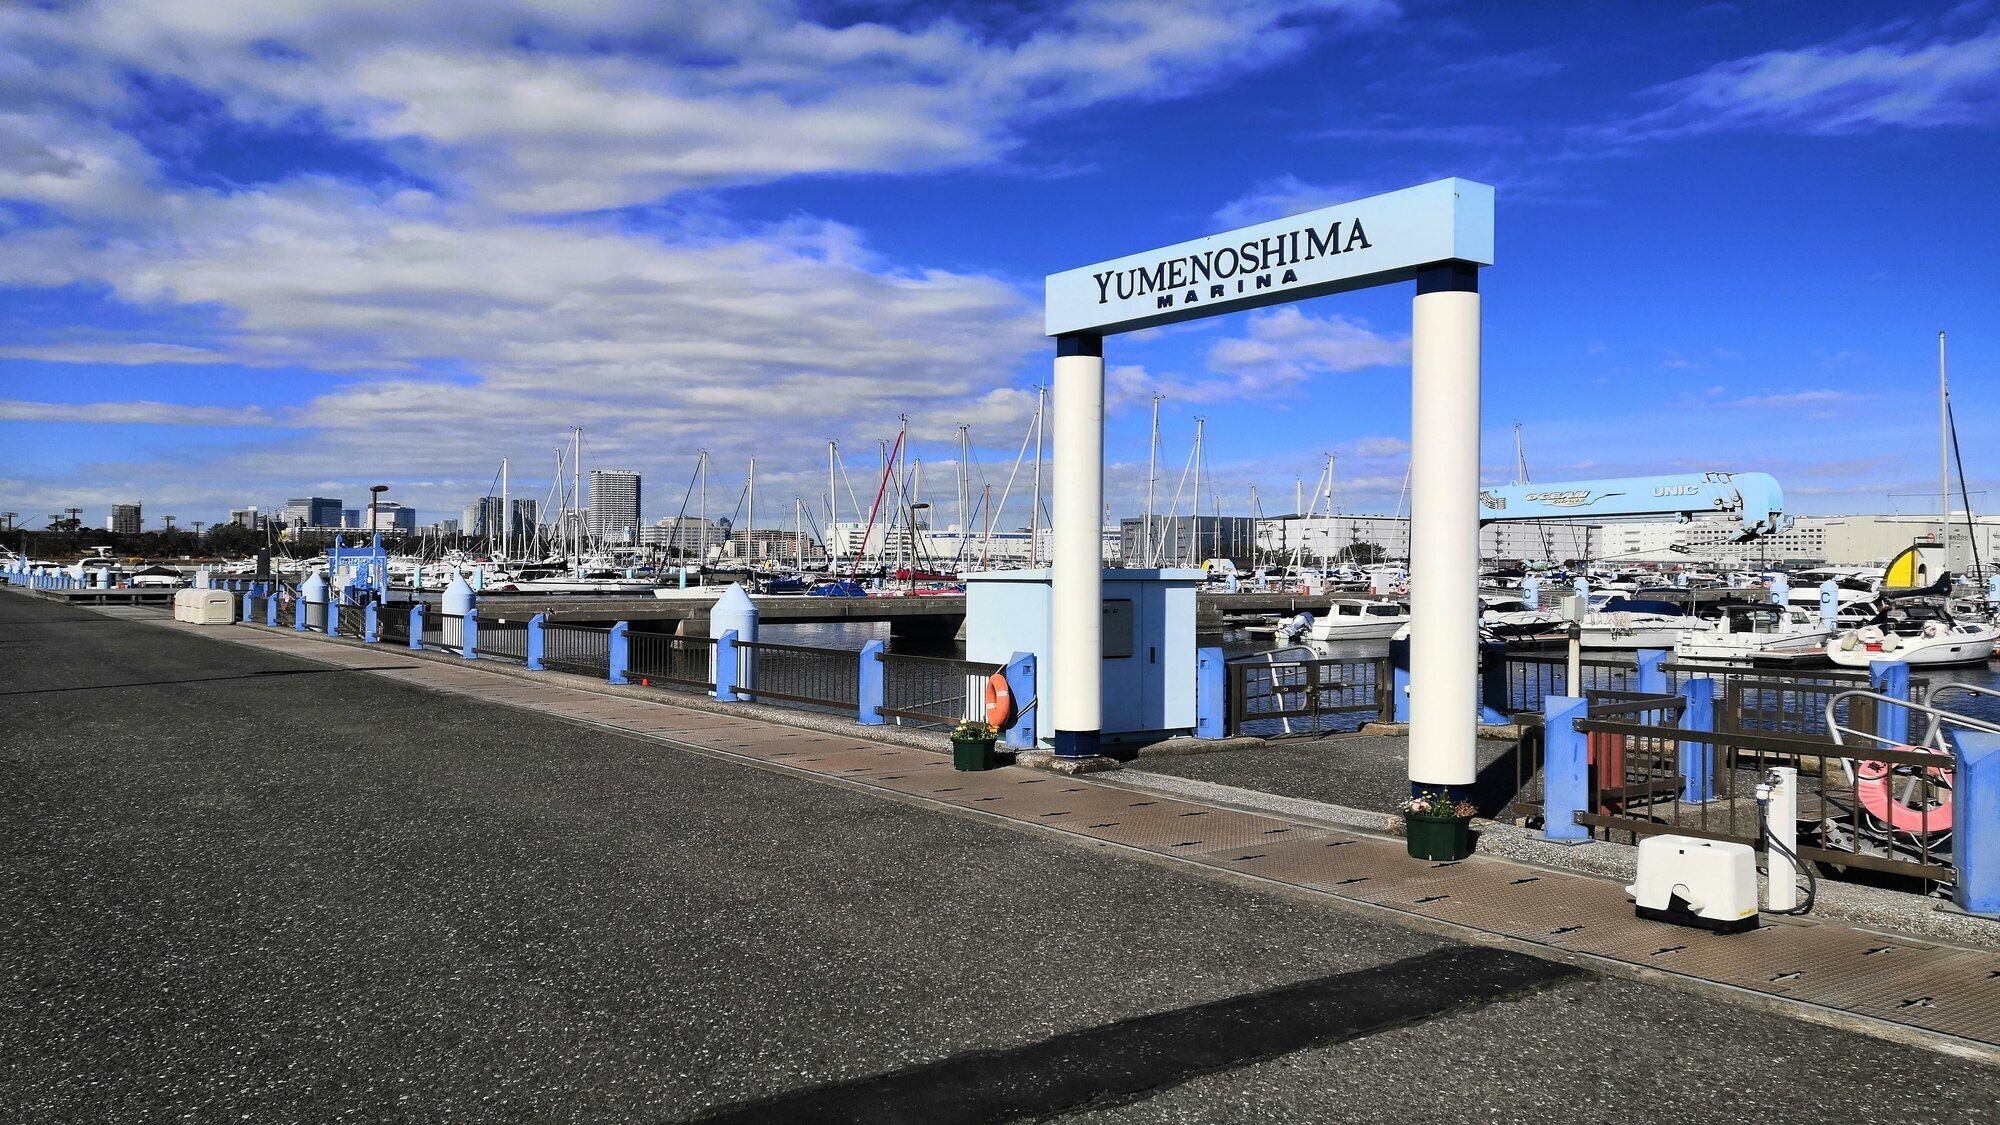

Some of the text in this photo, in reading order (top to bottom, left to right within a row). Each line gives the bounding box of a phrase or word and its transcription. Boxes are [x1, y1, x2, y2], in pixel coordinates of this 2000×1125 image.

[1093, 217, 1372, 304] YUMENOSHIMA
[1157, 269, 1298, 309] MARINA
[1525, 490, 1591, 501] OCEAN
[1652, 486, 1699, 497] UNIC
[1524, 588, 1532, 599] C
[1771, 592, 1780, 605] C
[1821, 592, 1830, 603] C
